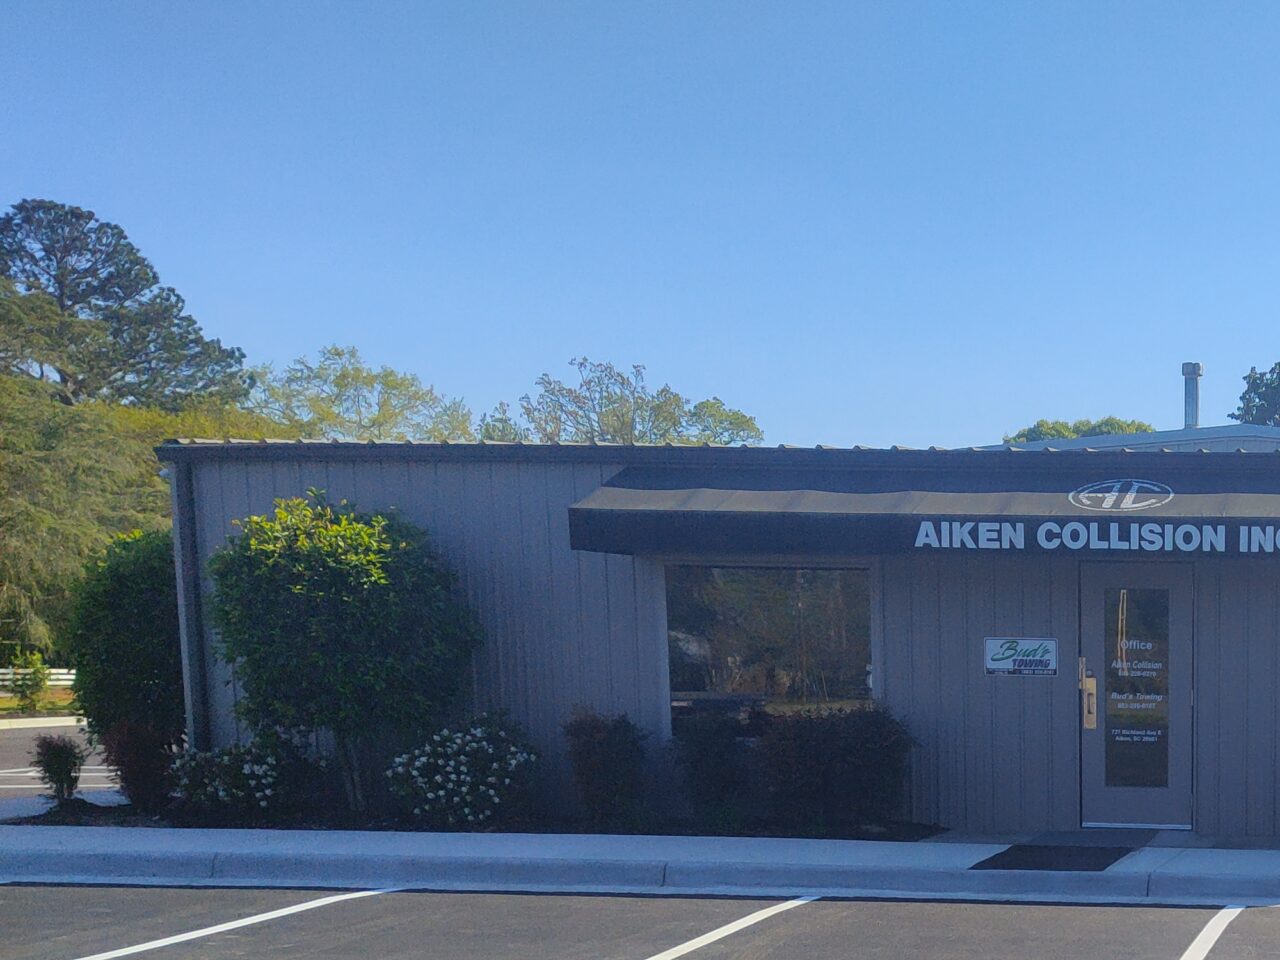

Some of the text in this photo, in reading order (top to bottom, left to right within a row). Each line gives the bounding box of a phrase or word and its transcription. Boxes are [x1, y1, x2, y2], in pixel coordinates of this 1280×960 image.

[914, 520, 1025, 549] AIKEN
[1036, 521, 1226, 553] COLLISION
[1120, 639, 1153, 650] Office
[990, 640, 1051, 662] Bud's
[1012, 658, 1051, 669] TOWING
[1132, 660, 1163, 669] Collision
[1111, 692, 1163, 702] Bud's Towing
